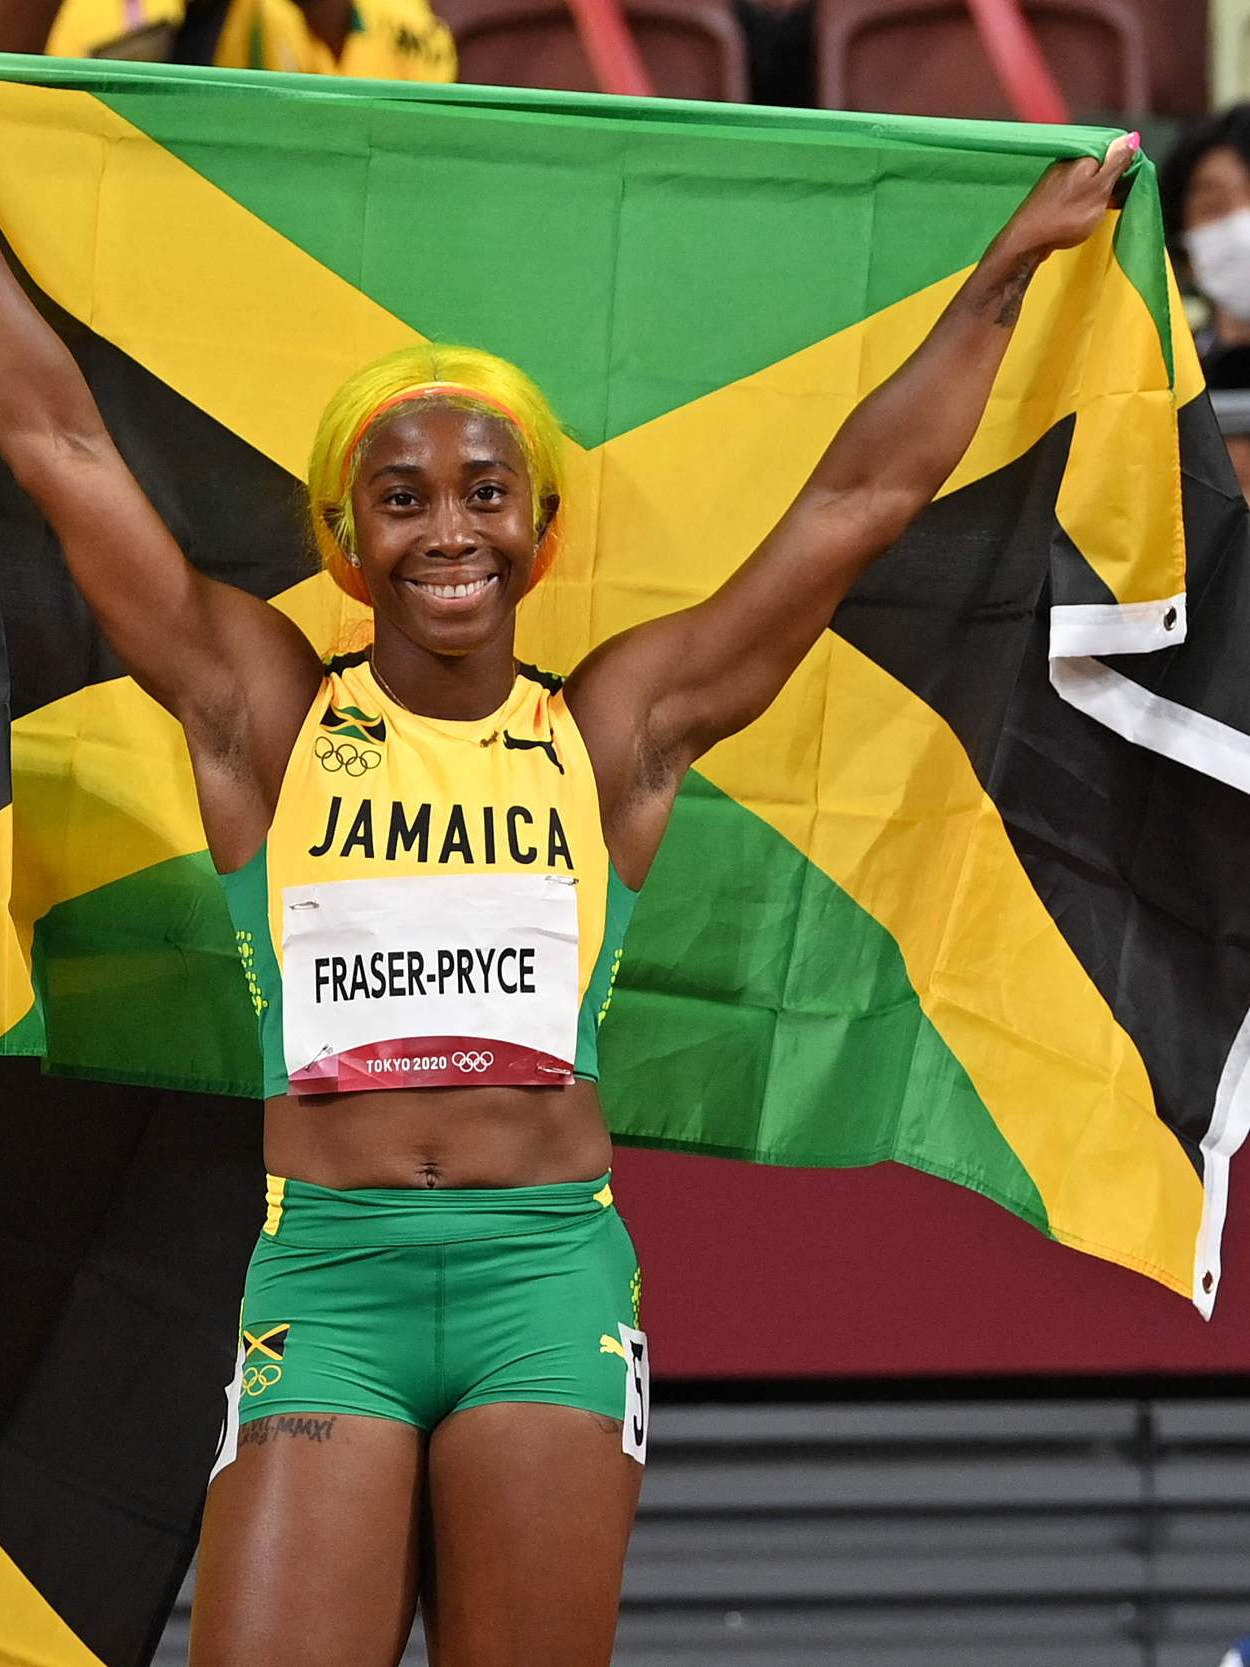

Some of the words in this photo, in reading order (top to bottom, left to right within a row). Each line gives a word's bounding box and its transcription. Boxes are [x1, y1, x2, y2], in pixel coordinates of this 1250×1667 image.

[308, 796, 575, 871] JAMAICA
[314, 946, 536, 1004] FRASER-PRYCE
[365, 1057, 411, 1074] TOKYO
[412, 1055, 447, 1072] 2020
[630, 1339, 644, 1447] 5
